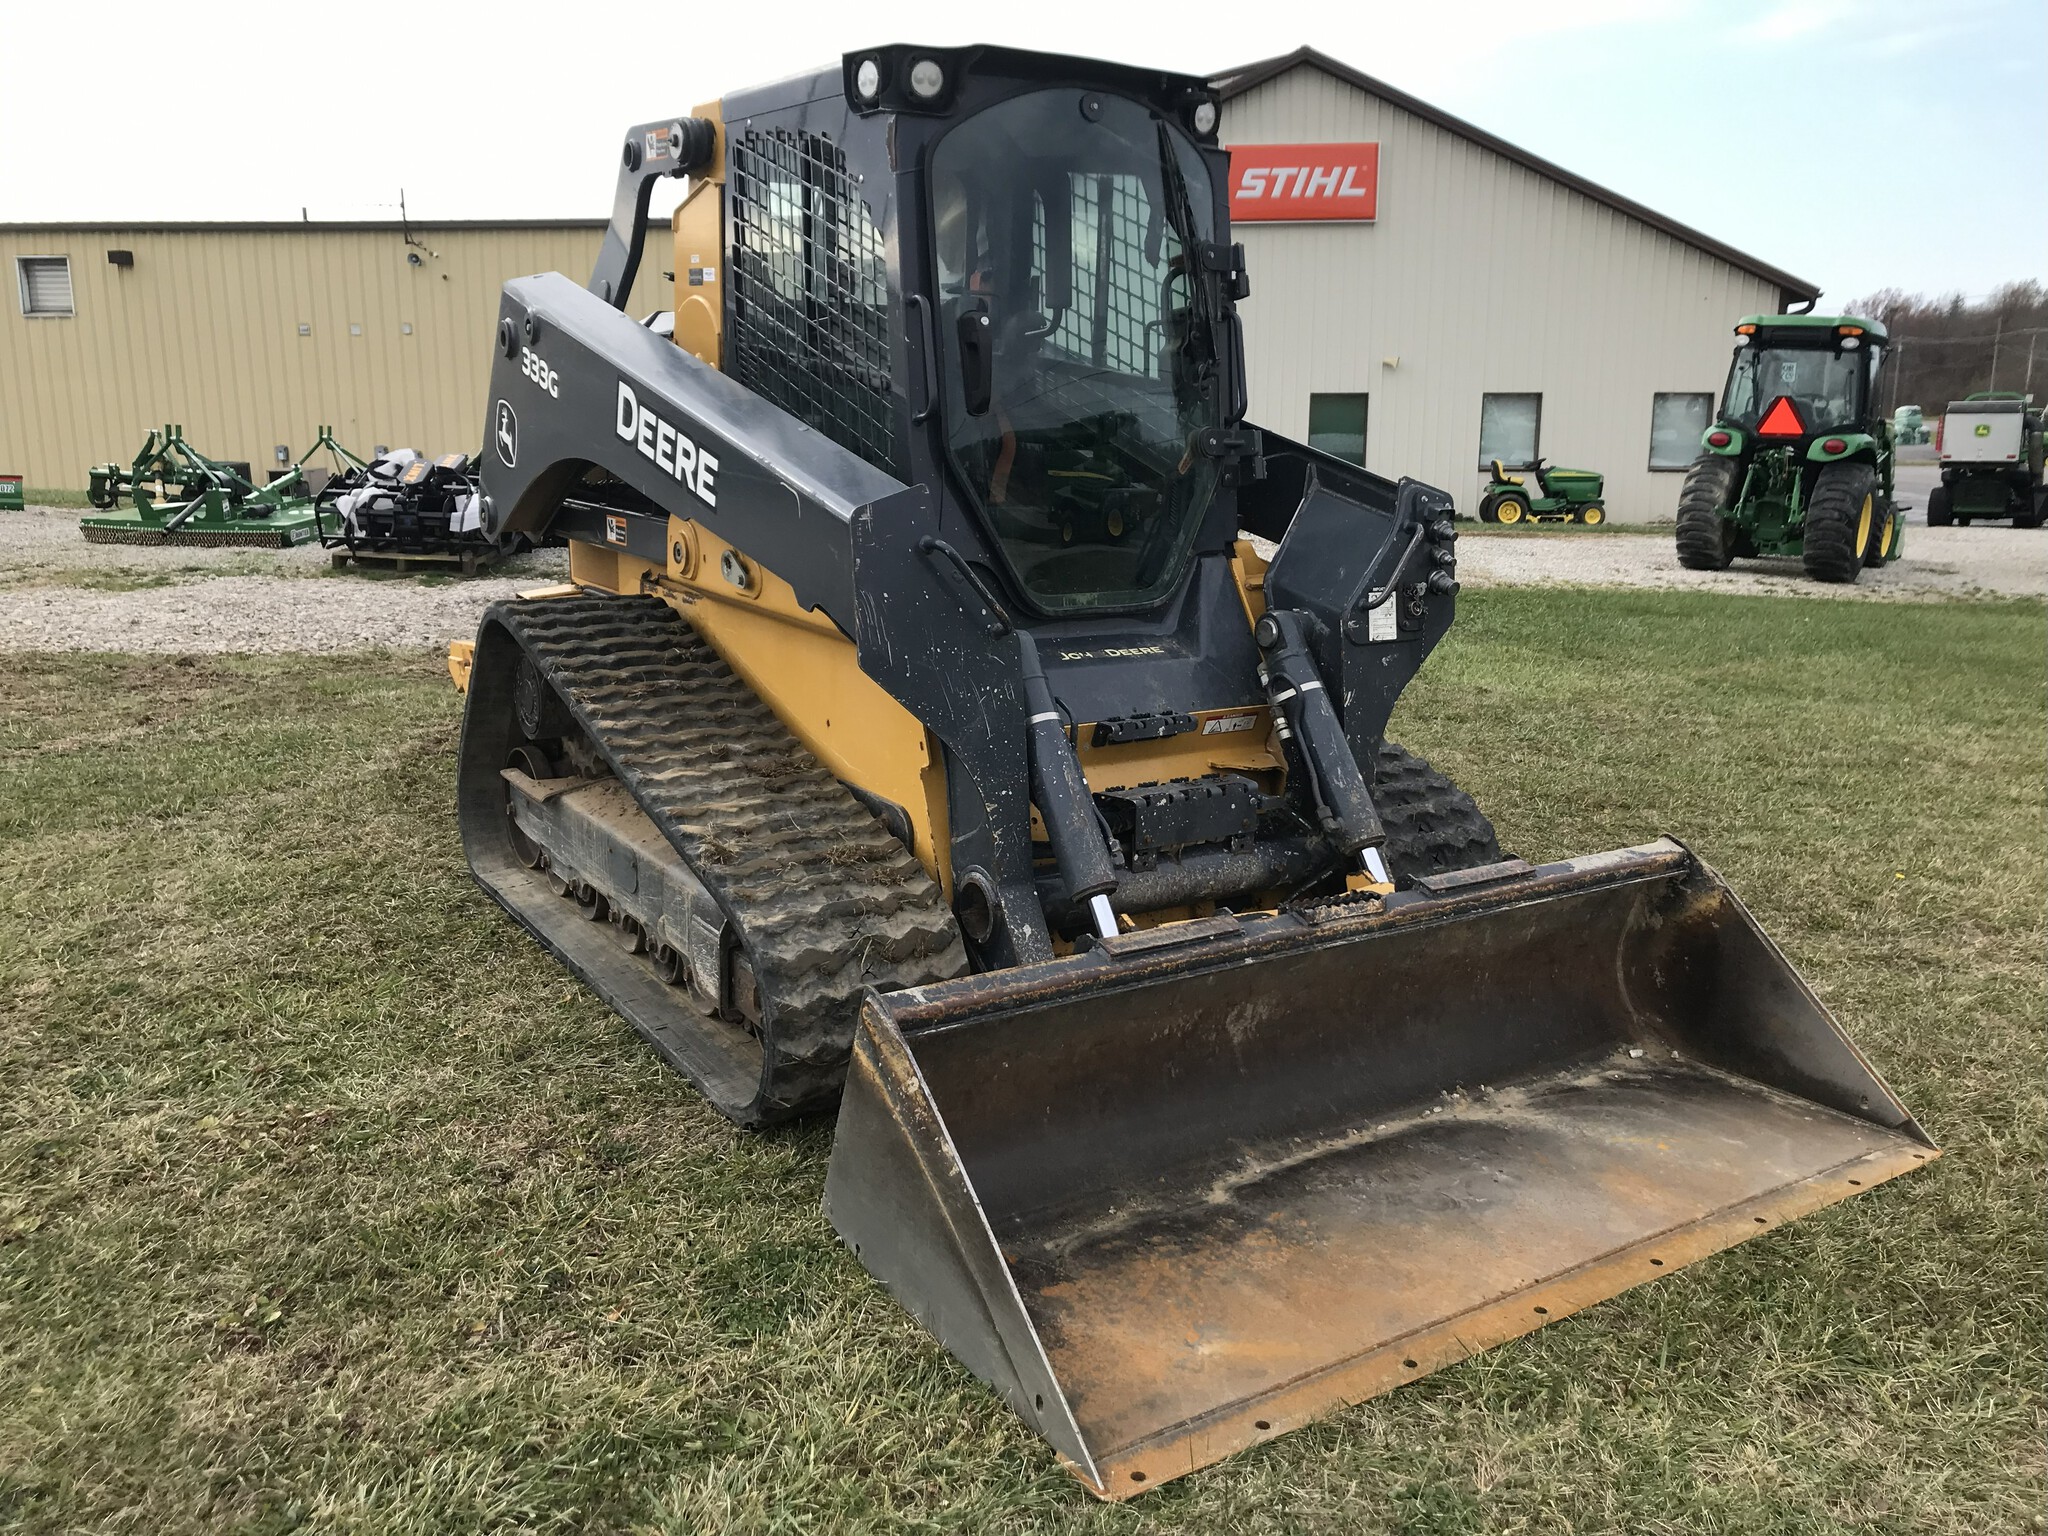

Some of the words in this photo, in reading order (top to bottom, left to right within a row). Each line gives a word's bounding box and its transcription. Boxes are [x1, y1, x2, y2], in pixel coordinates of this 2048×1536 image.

[1235, 166, 1366, 199] STIHL
[521, 346, 560, 399] 333G
[615, 380, 719, 508] DEERE
[1104, 646, 1165, 657] DEERE
